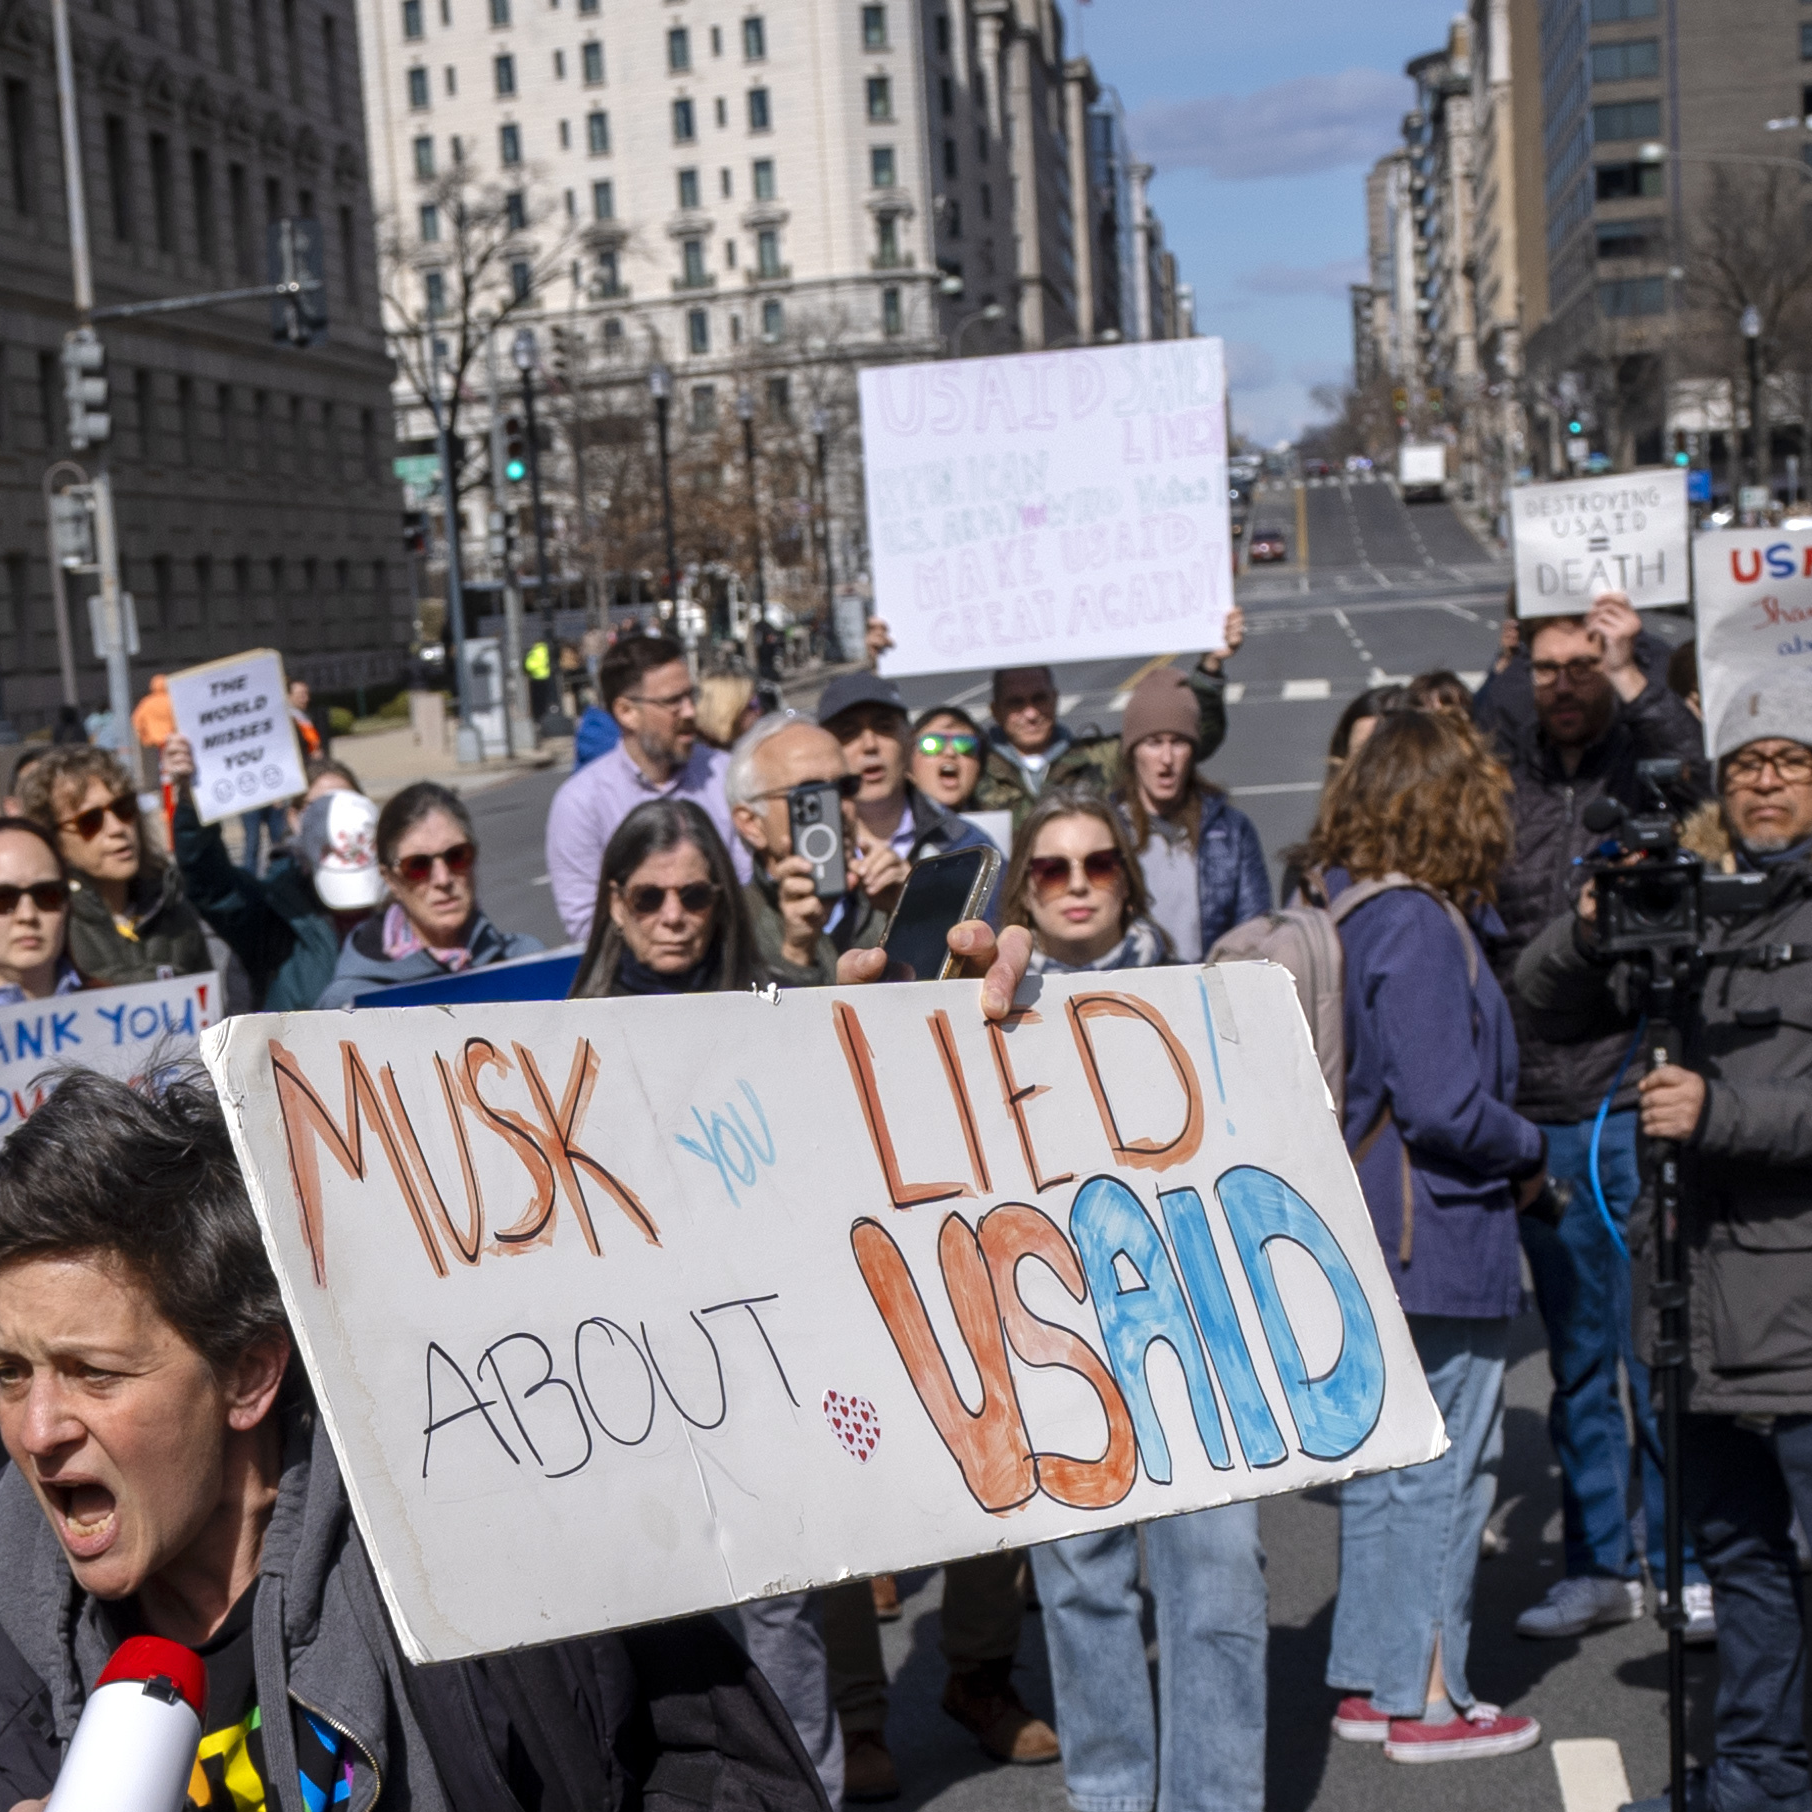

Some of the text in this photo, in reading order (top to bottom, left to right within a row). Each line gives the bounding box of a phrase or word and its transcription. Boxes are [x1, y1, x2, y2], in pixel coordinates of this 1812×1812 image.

[1524, 485, 1662, 518] DESTROYING
[1549, 510, 1648, 540] USAID
[1536, 550, 1665, 596] DEATH
[210, 673, 249, 697] THE
[199, 694, 269, 725] WORLD
[203, 717, 274, 750] MISSES
[223, 746, 265, 771] YOU
[96, 984, 211, 1046] YOU!
[270, 974, 1238, 1288] MUSK YOU LIED!
[421, 1163, 1387, 1518] ABOUT USAID
